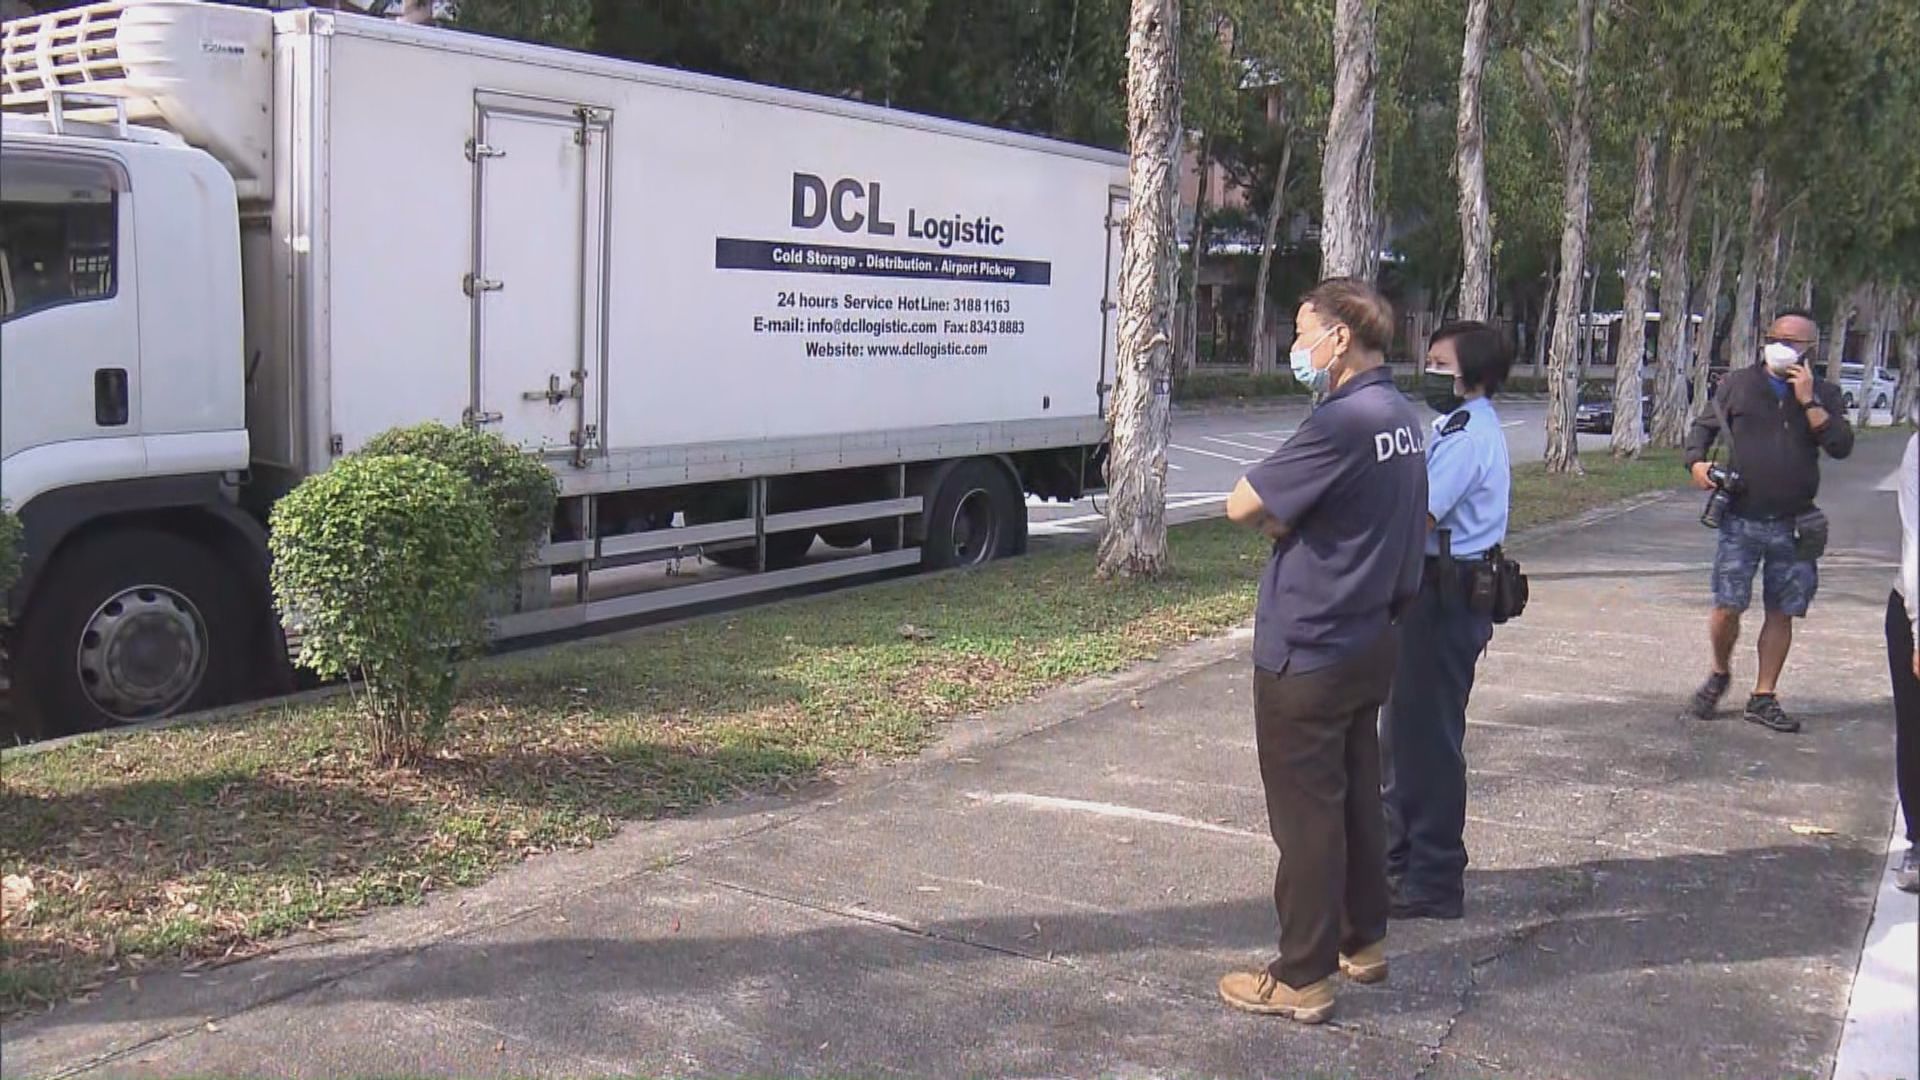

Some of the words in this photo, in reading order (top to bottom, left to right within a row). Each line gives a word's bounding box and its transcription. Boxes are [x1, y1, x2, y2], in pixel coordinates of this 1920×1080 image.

[791, 172, 895, 235] DCL
[908, 207, 1005, 249] Logistic
[772, 247, 803, 263] Cold
[806, 250, 856, 269] Storage
[866, 254, 932, 272] Distribution
[940, 260, 978, 277] Airport
[979, 262, 1015, 278] Pick-up
[777, 291, 796, 308] 24
[799, 292, 839, 309] hours
[843, 294, 893, 310] Service
[753, 316, 804, 333] E-mail:
[807, 318, 937, 337] info@dcllogistic.com
[806, 341, 864, 358] Website:
[867, 341, 988, 359] www.dcllogistic.com
